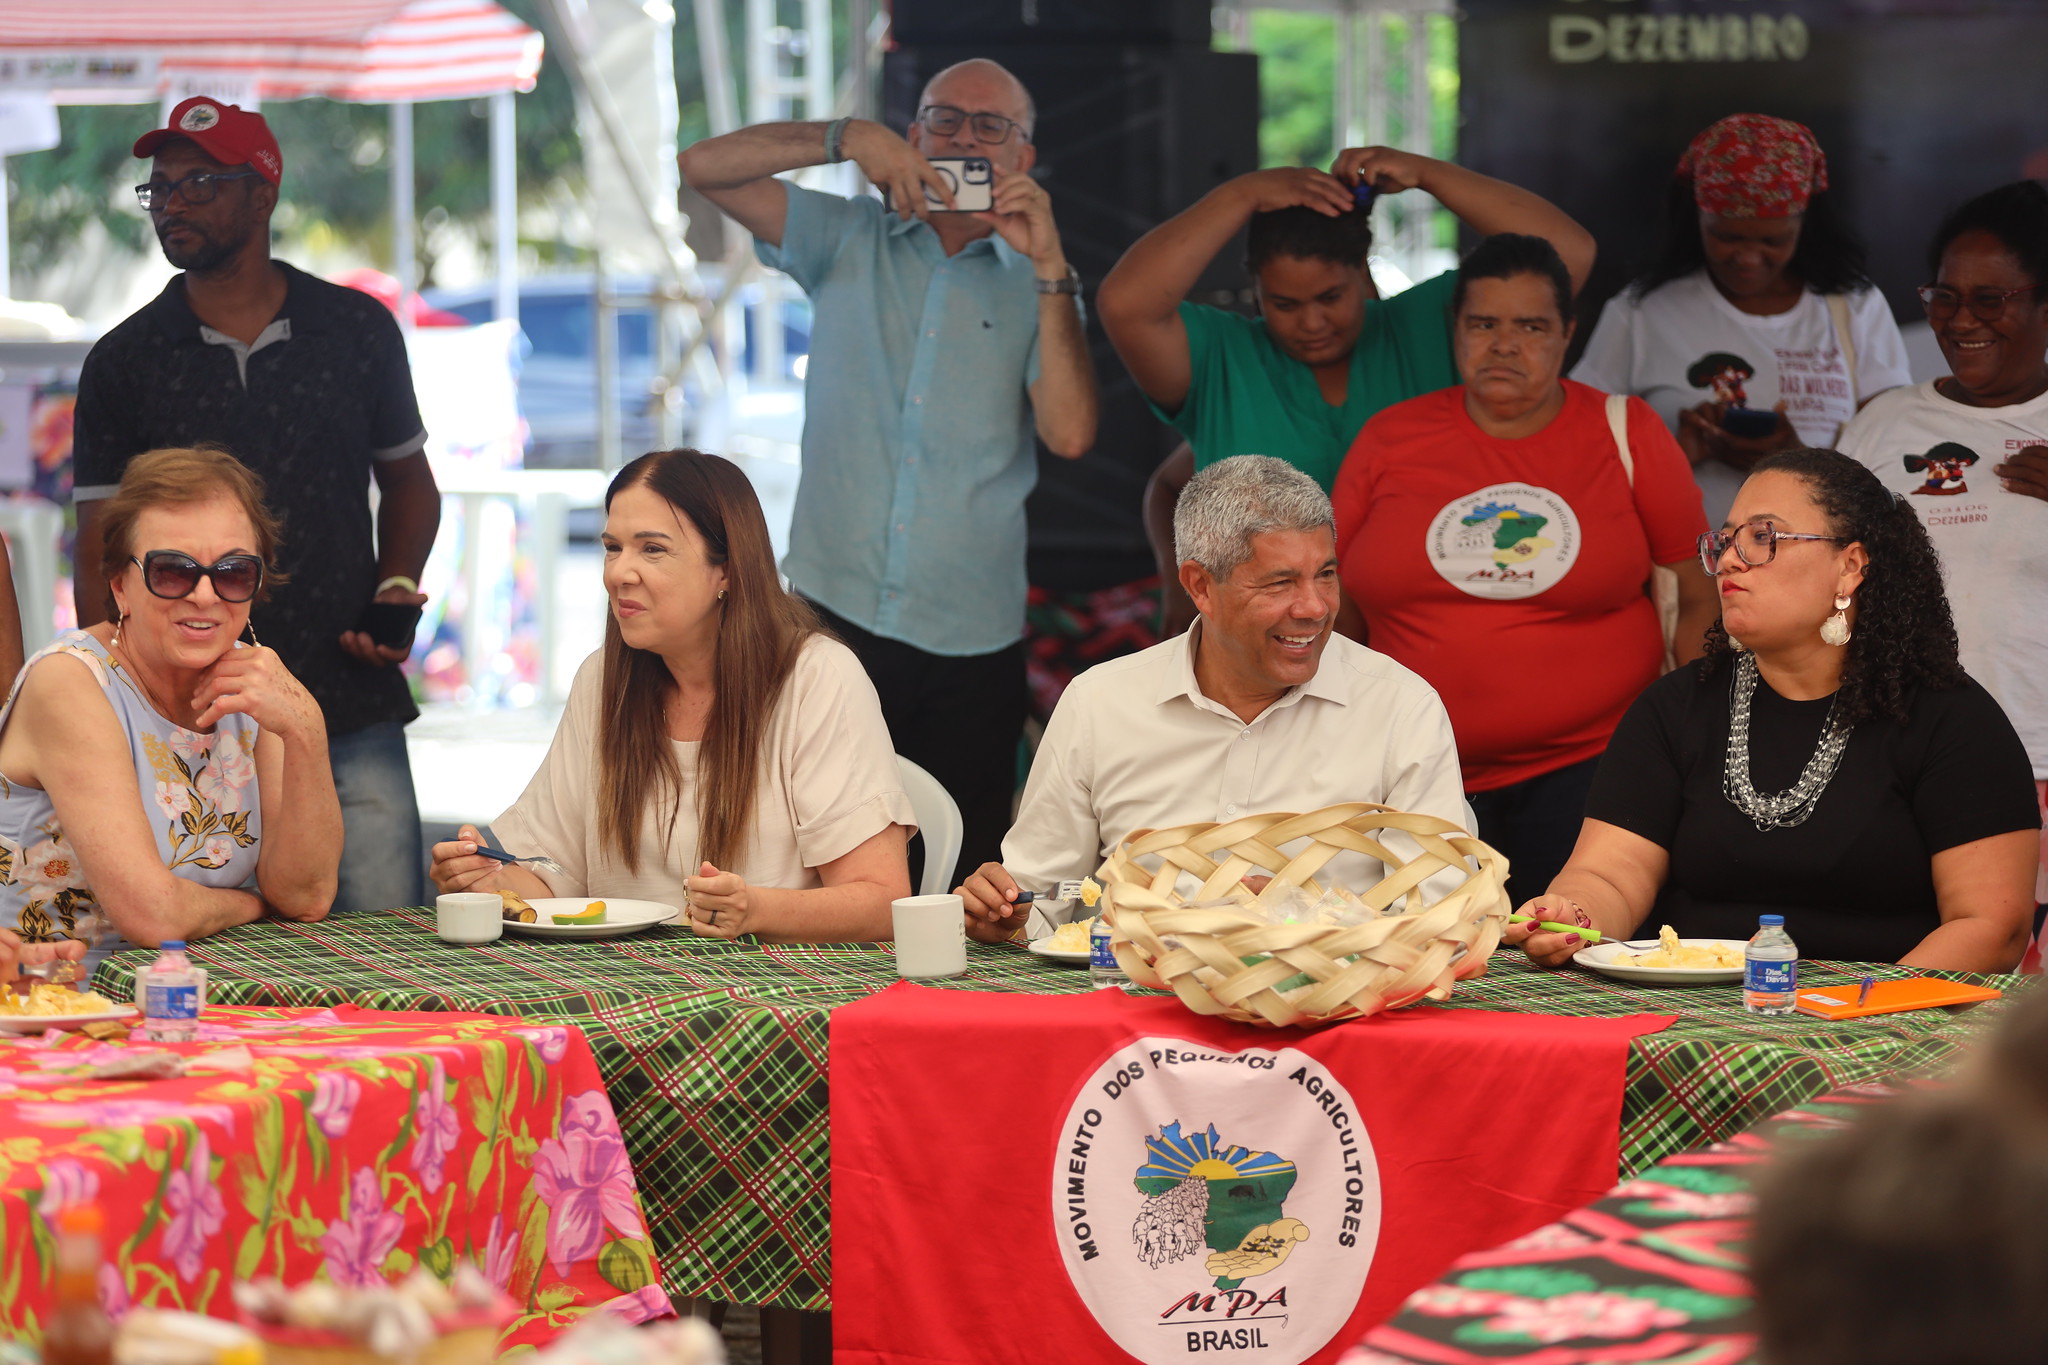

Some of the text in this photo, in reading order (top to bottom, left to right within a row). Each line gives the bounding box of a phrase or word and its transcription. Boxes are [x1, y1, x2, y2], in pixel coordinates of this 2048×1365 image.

[1549, 13, 1810, 63] DEZEMBRO
[1927, 513, 1988, 526] DEZEMBRO
[1068, 1048, 1364, 1262] MOVIMENTO DOS PEQUENOS AGRICULTORES
[1160, 1285, 1288, 1319] MPA
[1186, 1327, 1269, 1353] BRASIL
